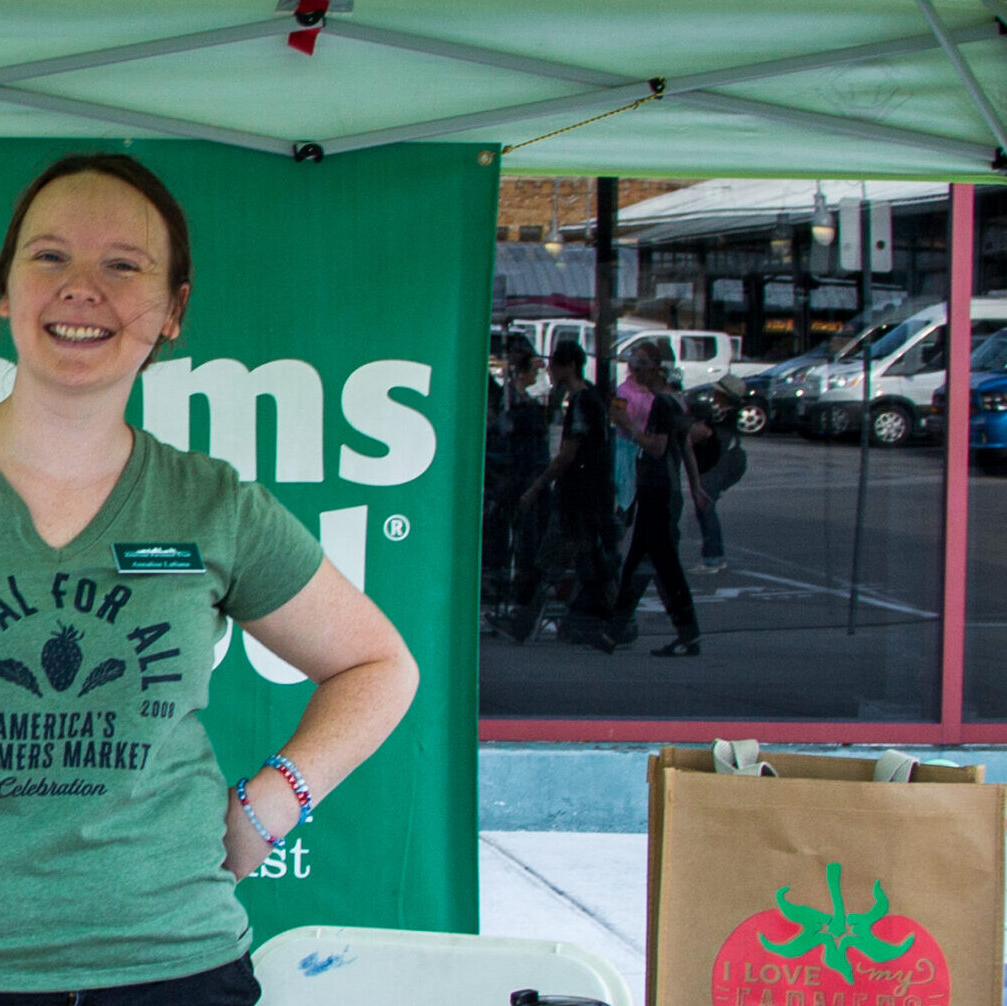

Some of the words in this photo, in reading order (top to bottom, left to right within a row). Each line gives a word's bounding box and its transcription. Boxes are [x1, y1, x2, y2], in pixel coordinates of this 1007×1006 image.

[51, 572, 133, 625] FOR
[126, 622, 182, 691] ALL
[62, 741, 152, 771] MARKET
[723, 961, 730, 981] I
[745, 962, 822, 986] LOVE
[857, 958, 936, 997] my
